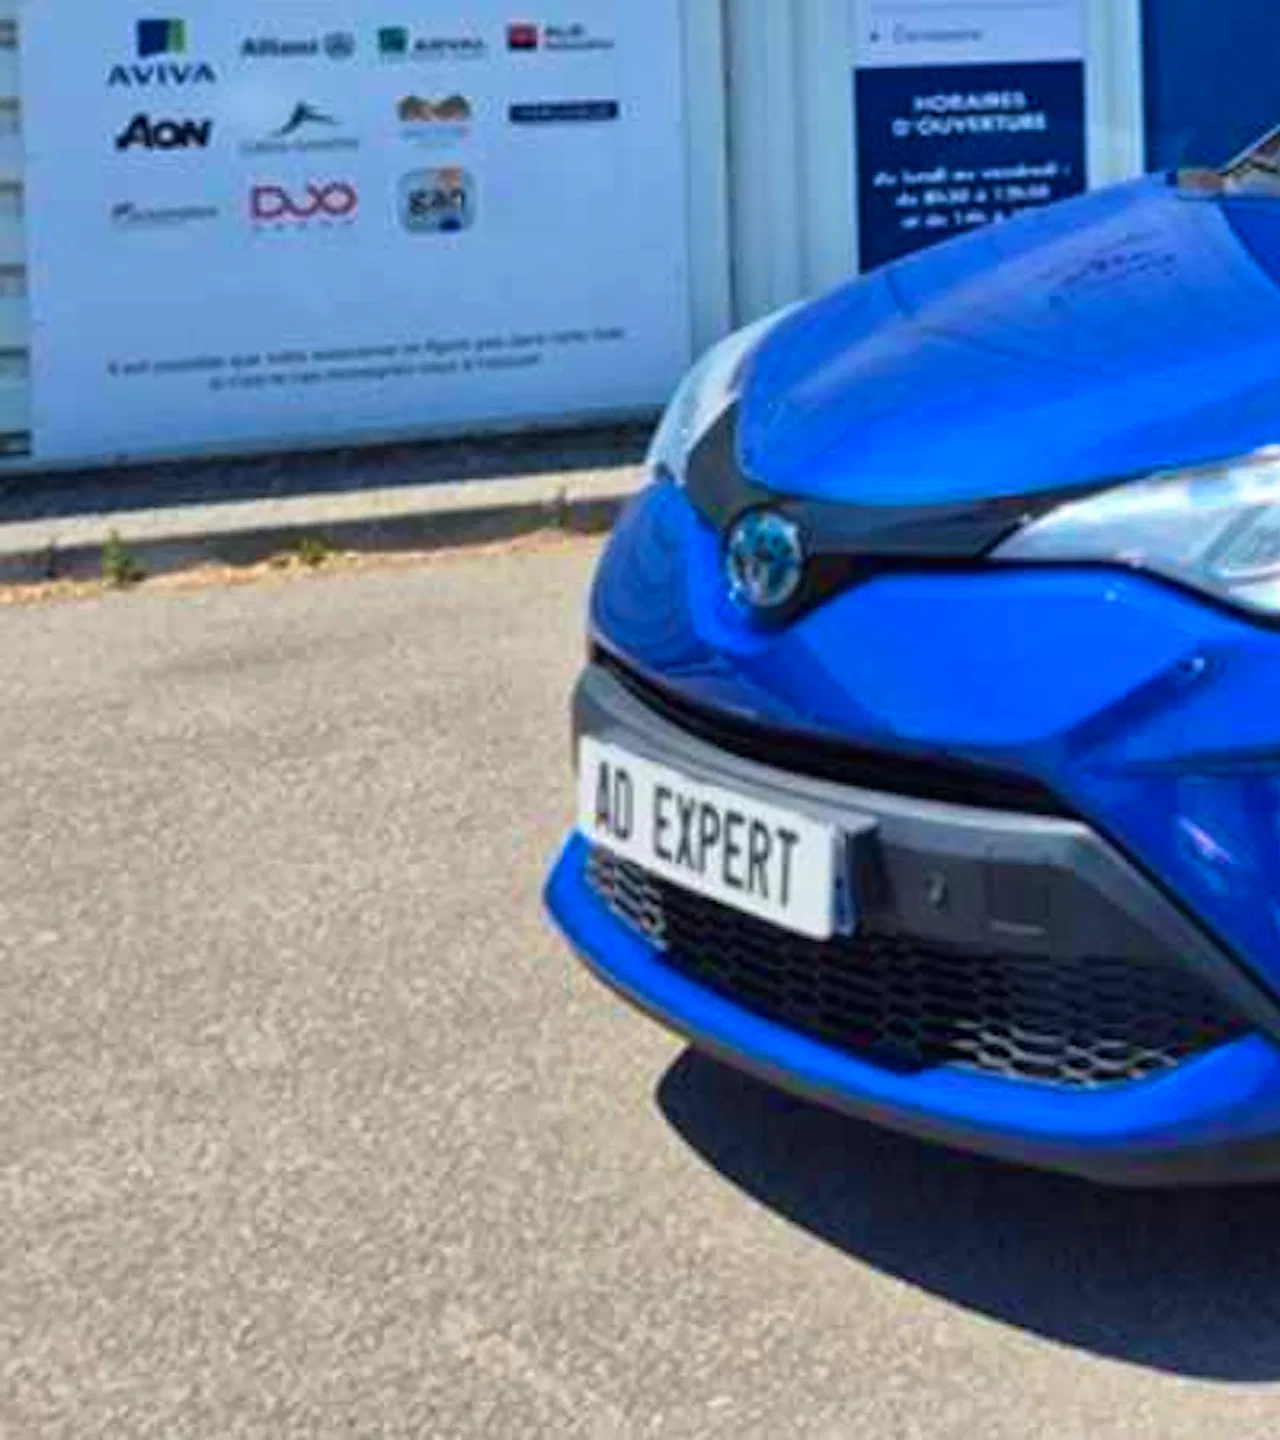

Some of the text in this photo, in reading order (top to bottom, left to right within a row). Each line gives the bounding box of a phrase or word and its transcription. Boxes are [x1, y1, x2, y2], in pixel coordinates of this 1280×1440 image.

[106, 62, 217, 88] AVIVA
[914, 91, 1026, 112] HORAIRES
[594, 759, 800, 909] AD EXPERT
